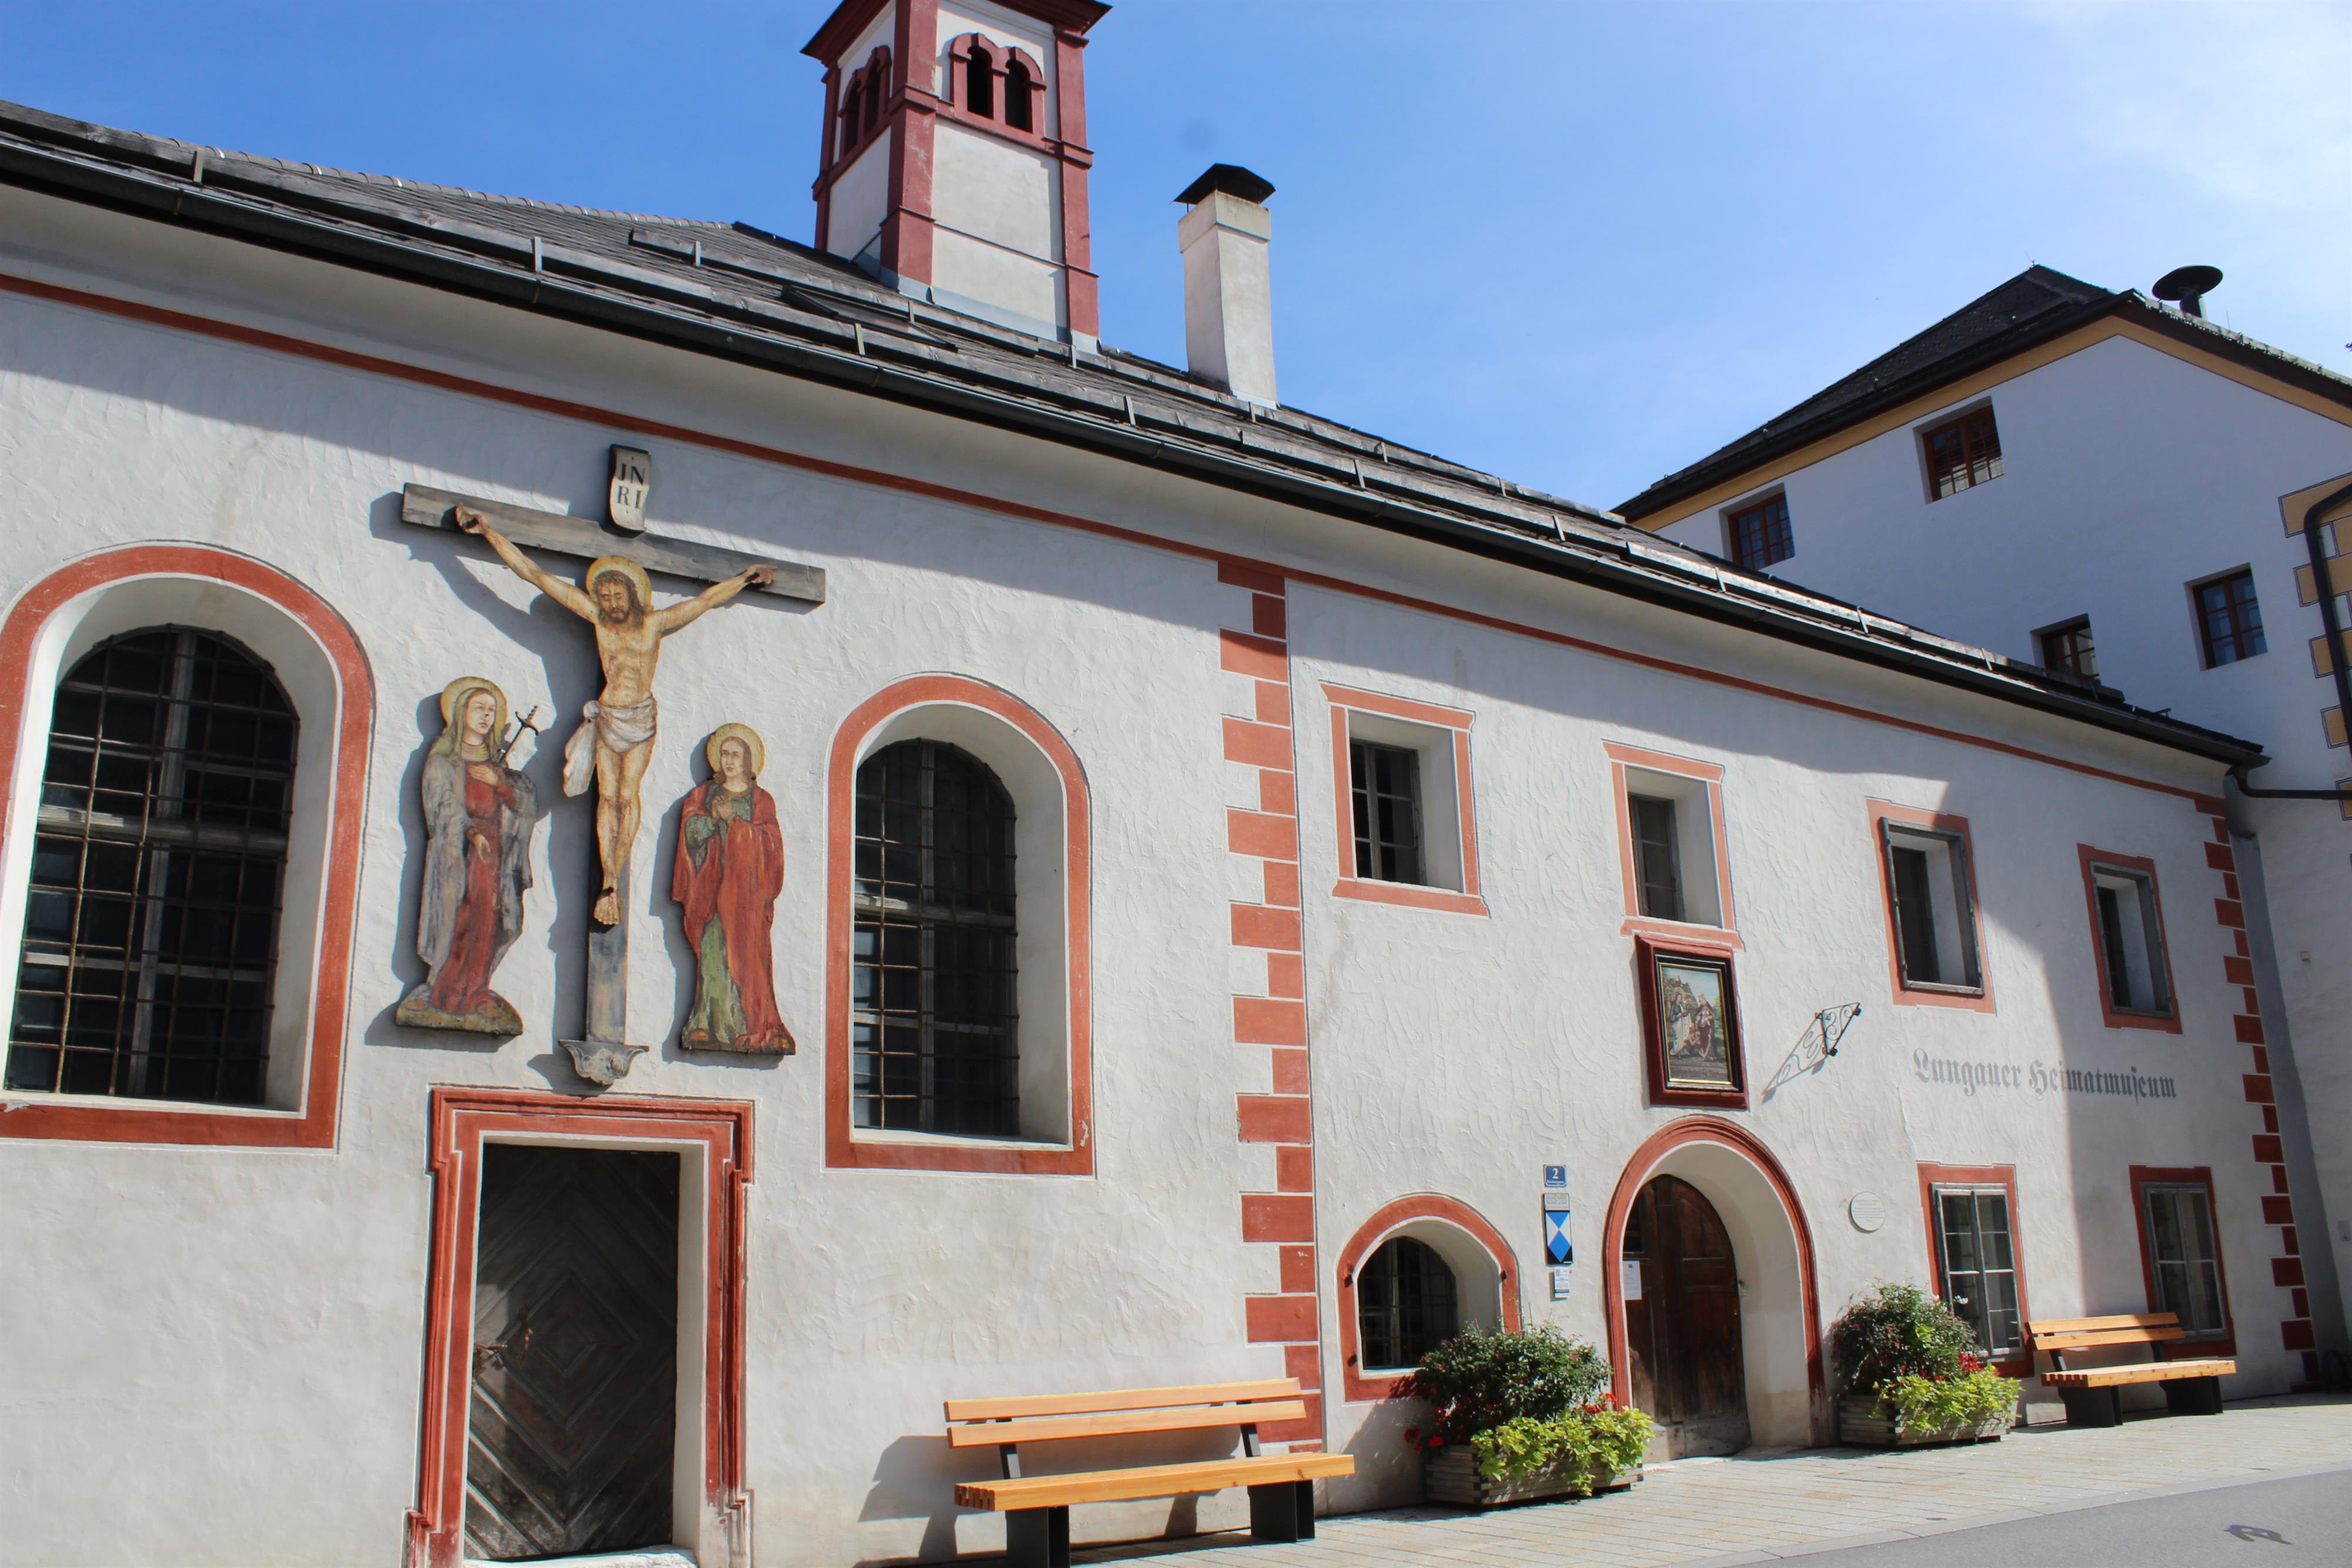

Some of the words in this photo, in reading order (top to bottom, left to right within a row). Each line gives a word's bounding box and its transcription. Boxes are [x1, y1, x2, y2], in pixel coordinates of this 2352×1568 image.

[617, 486, 642, 509] RI
[1913, 1048, 2022, 1096] Lungauer
[2029, 1059, 2177, 1105] Heimatmuseum
[1553, 1168, 1559, 1179] 2
